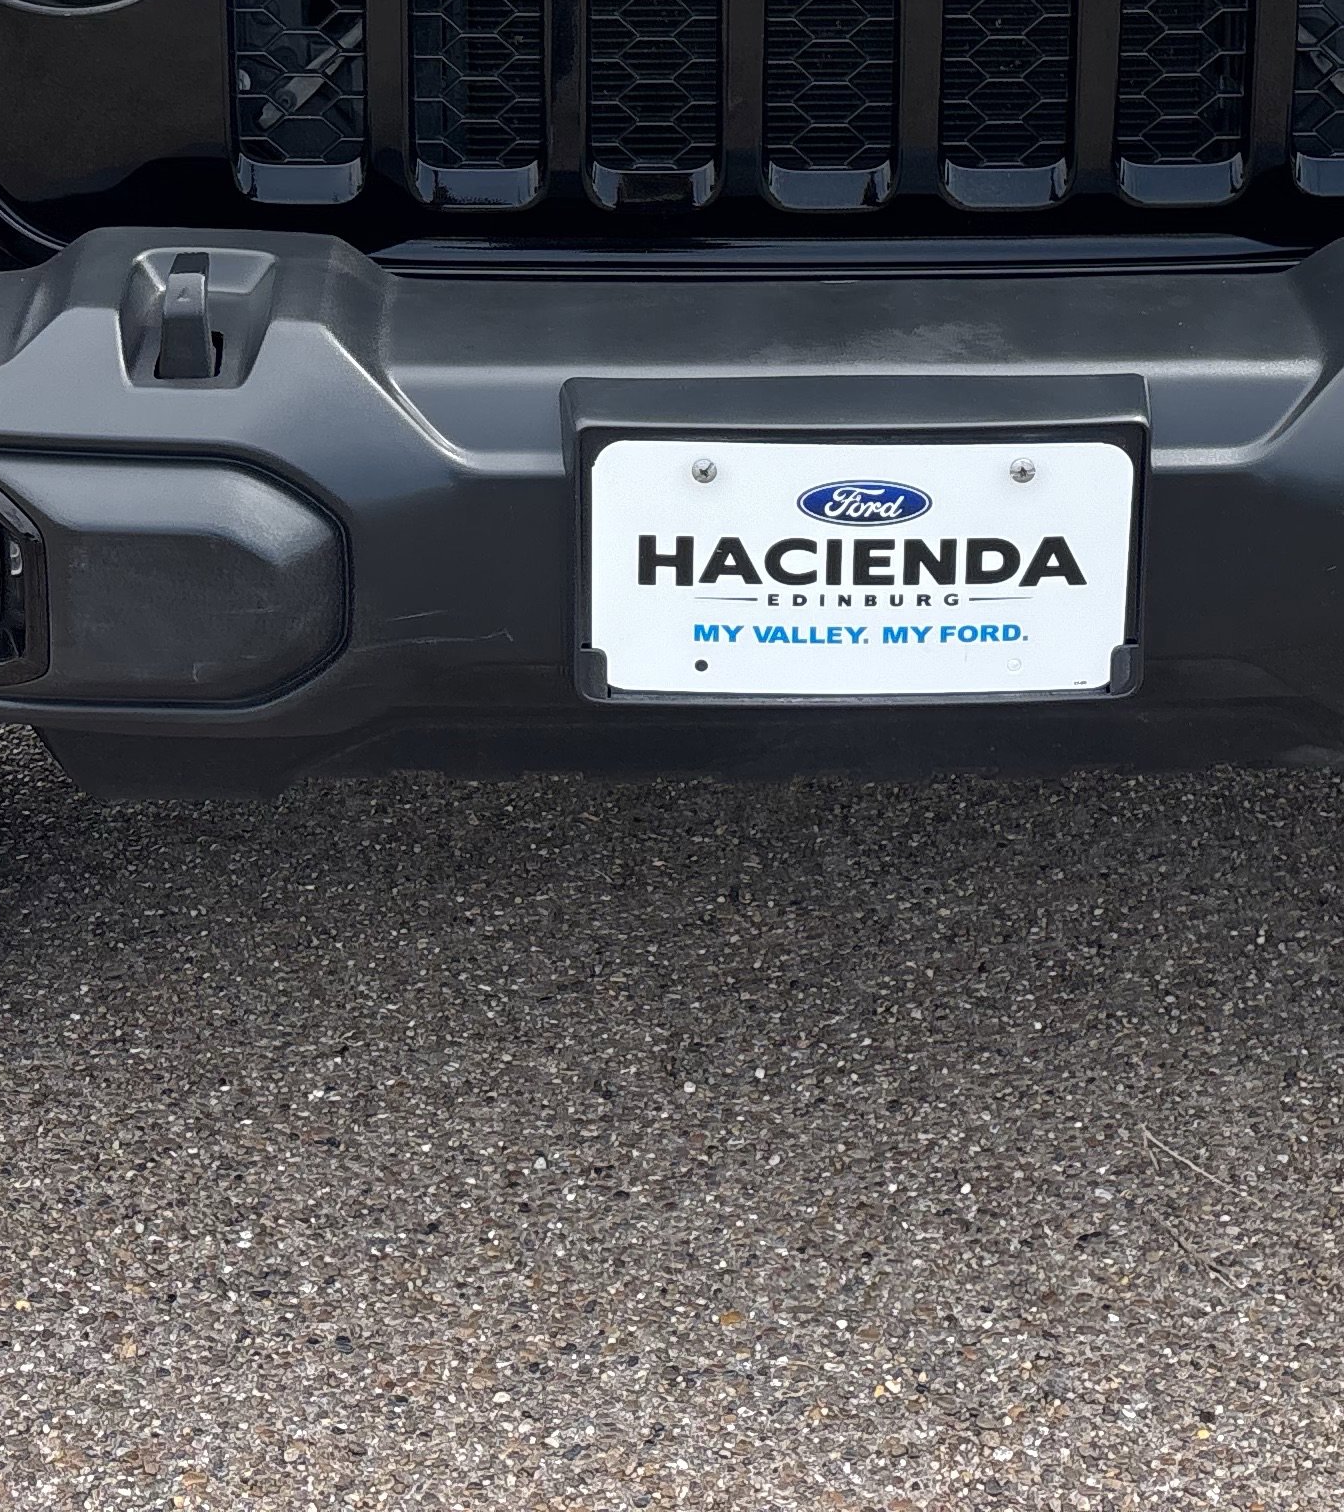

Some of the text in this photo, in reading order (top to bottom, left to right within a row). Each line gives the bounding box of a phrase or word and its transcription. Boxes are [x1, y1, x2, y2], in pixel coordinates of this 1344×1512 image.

[637, 534, 1087, 587] HACIENDA
[767, 593, 960, 607] EDINBURG
[693, 623, 1029, 645] MY VALLEY. MY FORD.
